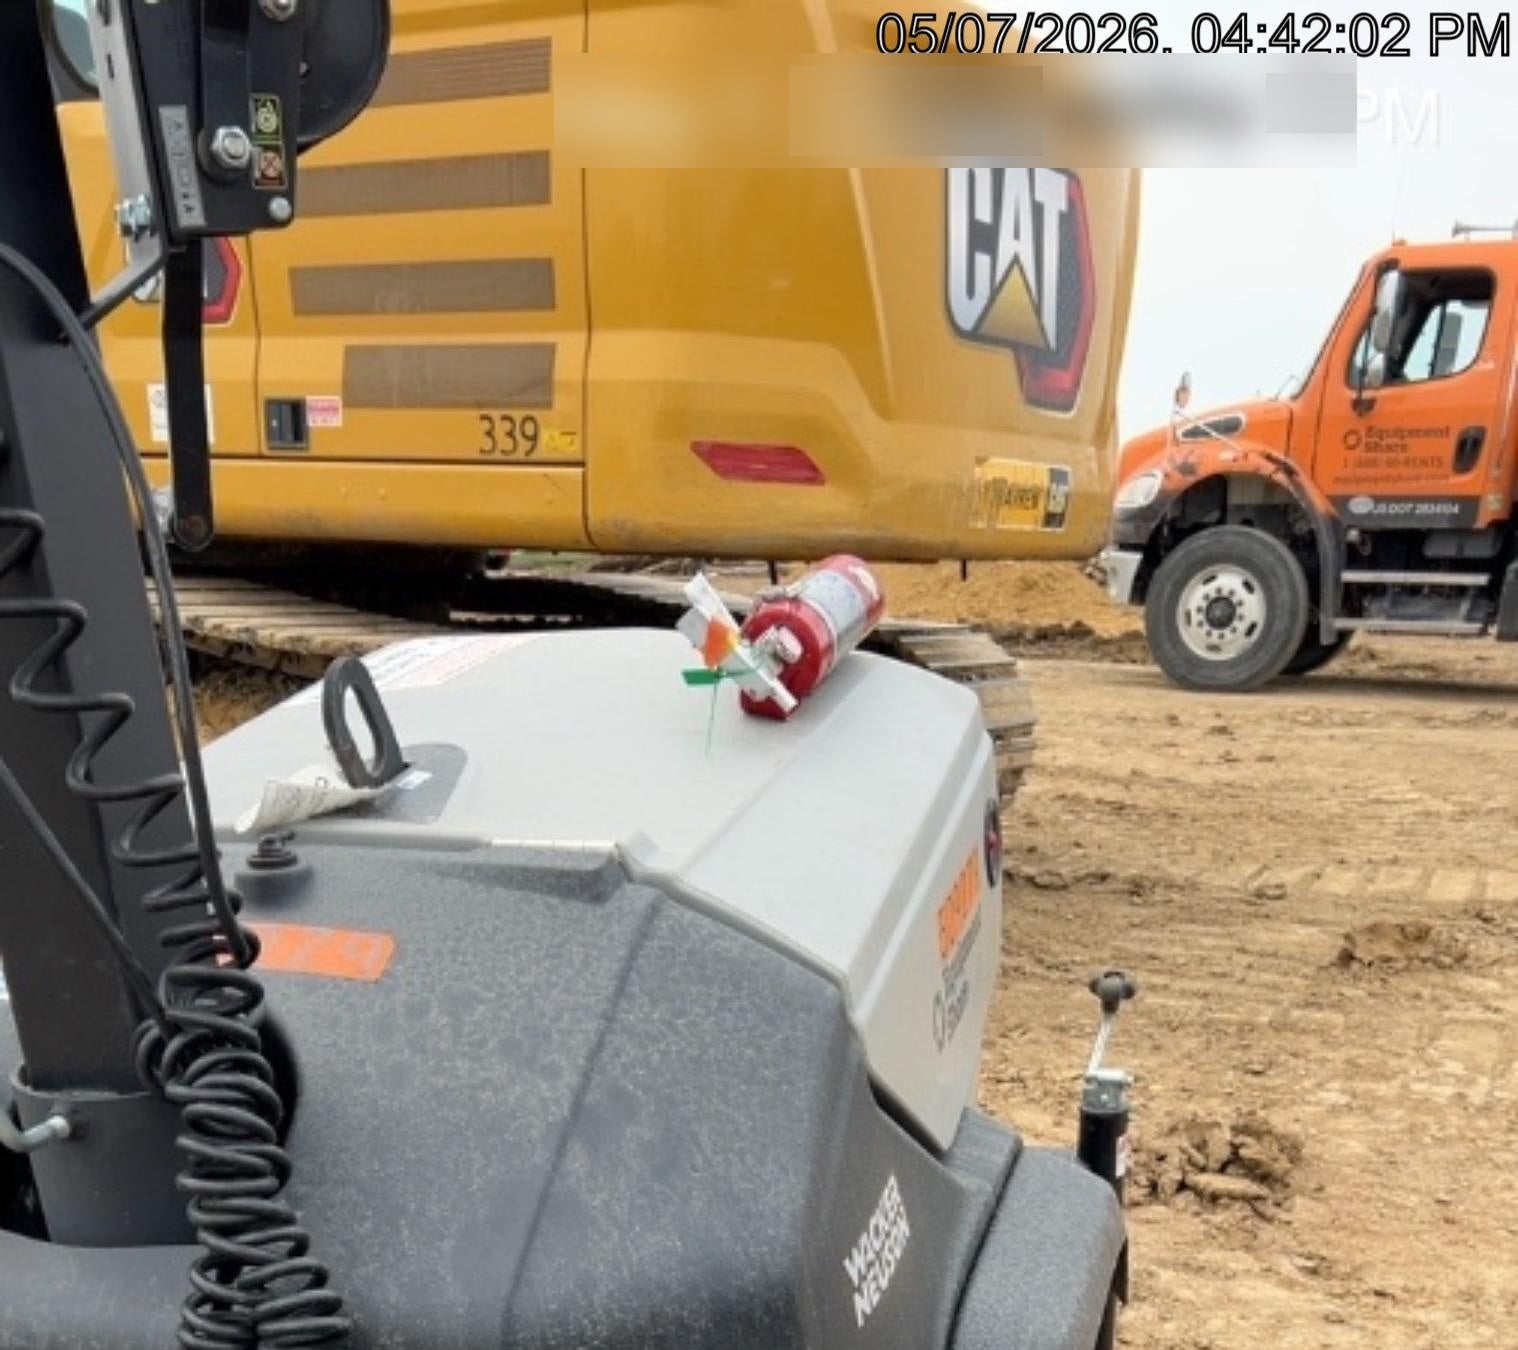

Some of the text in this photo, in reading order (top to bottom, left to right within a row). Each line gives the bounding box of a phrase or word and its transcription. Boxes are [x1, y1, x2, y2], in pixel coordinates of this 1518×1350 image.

[946, 168, 1068, 351] CAT
[479, 414, 538, 456] 339
[842, 1174, 901, 1288] WACKER
[853, 1203, 911, 1329] NEUSON
